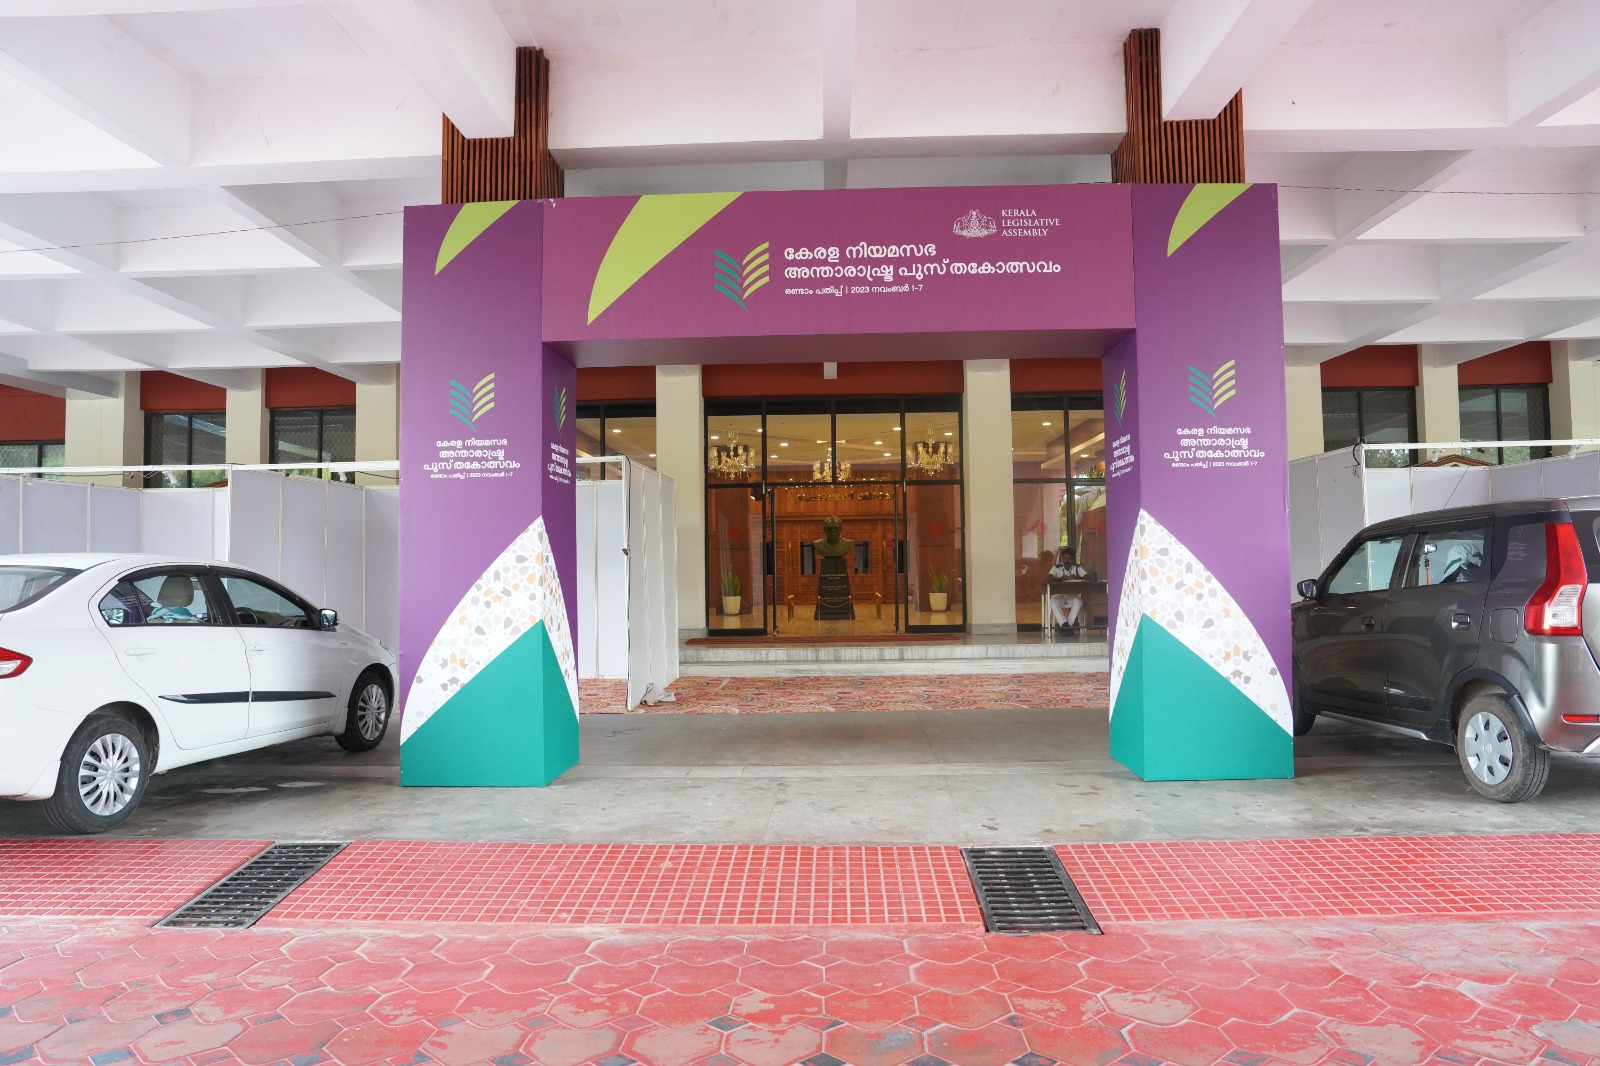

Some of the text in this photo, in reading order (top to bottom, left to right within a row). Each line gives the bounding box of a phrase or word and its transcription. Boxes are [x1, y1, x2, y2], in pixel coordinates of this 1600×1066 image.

[1001, 209, 1037, 217] KERALA
[1001, 218, 1061, 227] LEGISLATIVE
[1001, 228, 1048, 237] ASSEMBLY
[784, 241, 937, 263] കേരള നിയമസഭ
[784, 264, 894, 282] അന്താരാഷ്ട്ര
[784, 287, 814, 295] രണ്ടാം
[815, 284, 843, 297] പതിപ്പ്
[850, 285, 870, 294] 2023
[911, 284, 924, 292] 1-7
[1176, 425, 1252, 437] കേരള നിയമസഭ
[436, 437, 508, 448] കേരള നിയമസഭ
